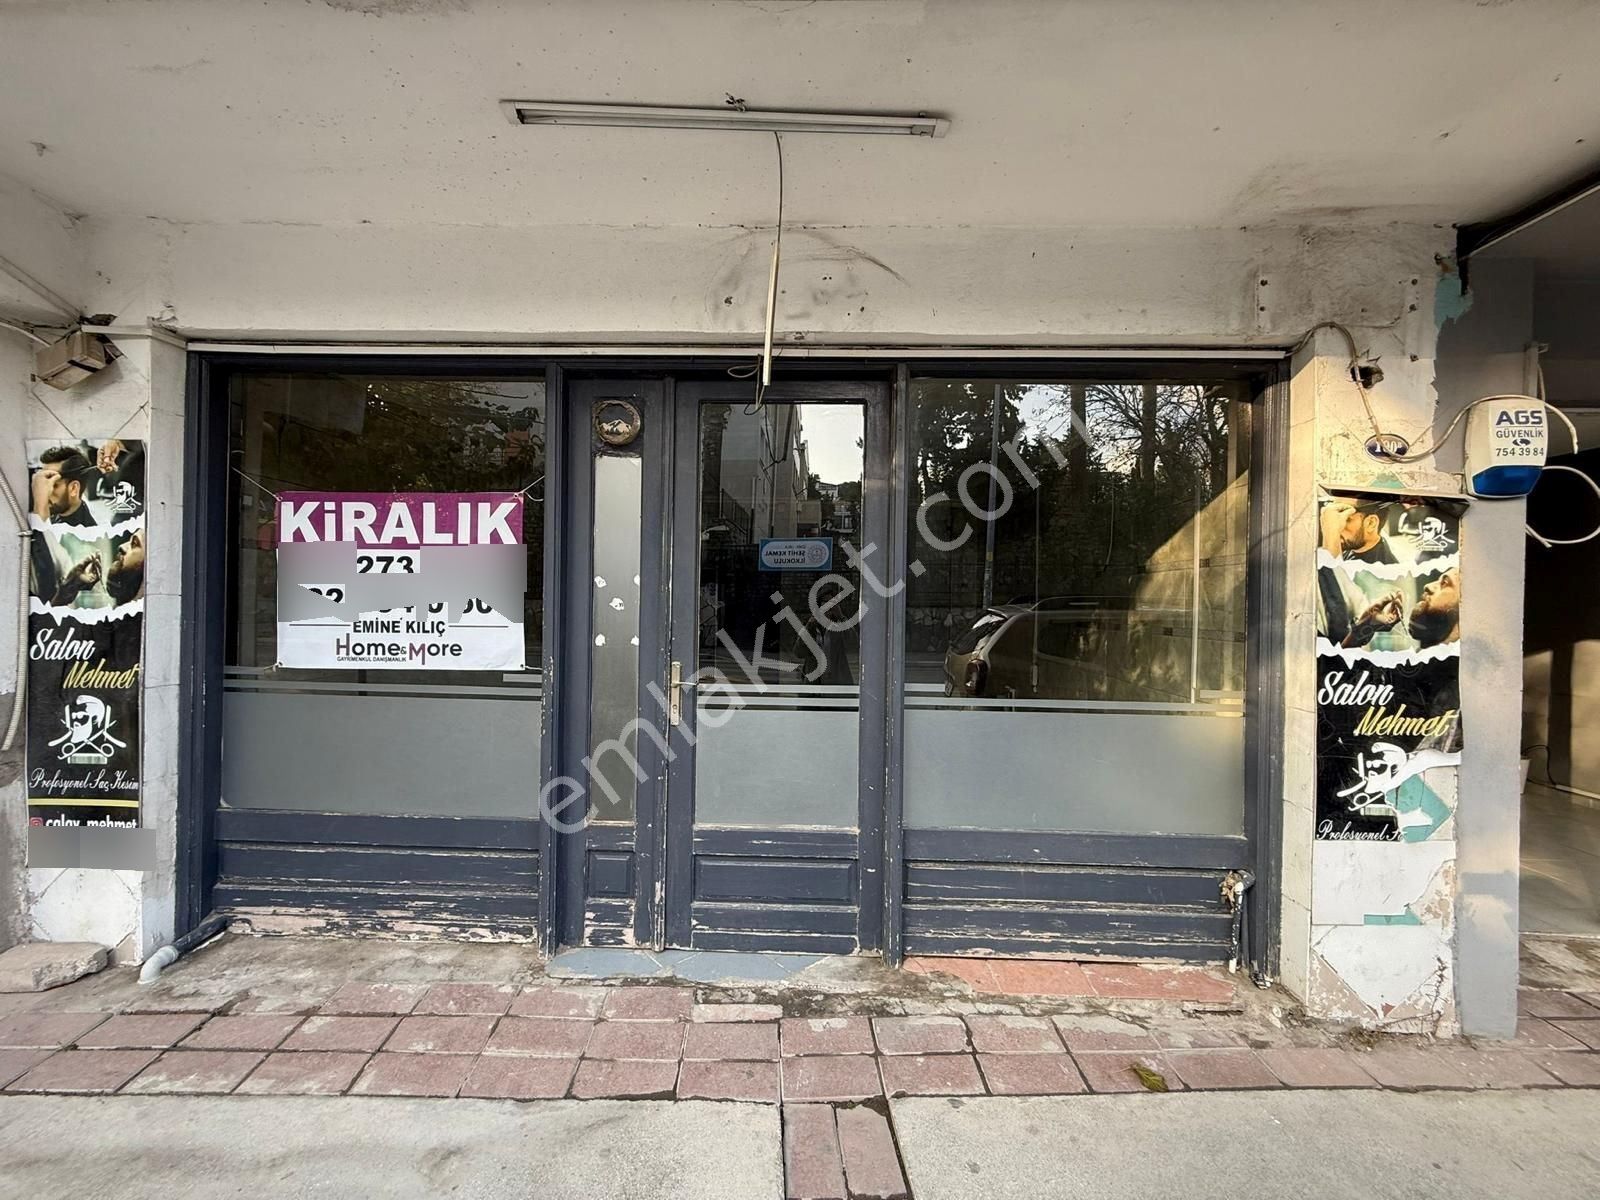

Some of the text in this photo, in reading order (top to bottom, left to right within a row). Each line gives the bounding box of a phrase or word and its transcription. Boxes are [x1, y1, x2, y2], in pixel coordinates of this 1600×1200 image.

[1495, 410, 1543, 426] AGS
[1496, 428, 1544, 439] GÜVENLİK
[1495, 447, 1544, 457] 754 39 84
[353, 617, 446, 637] EMİNE KILIÇ
[30, 627, 96, 661] Salon
[63, 658, 140, 690] Mehmet
[1317, 671, 1395, 706] Salon
[1353, 704, 1459, 738] Mehmet
